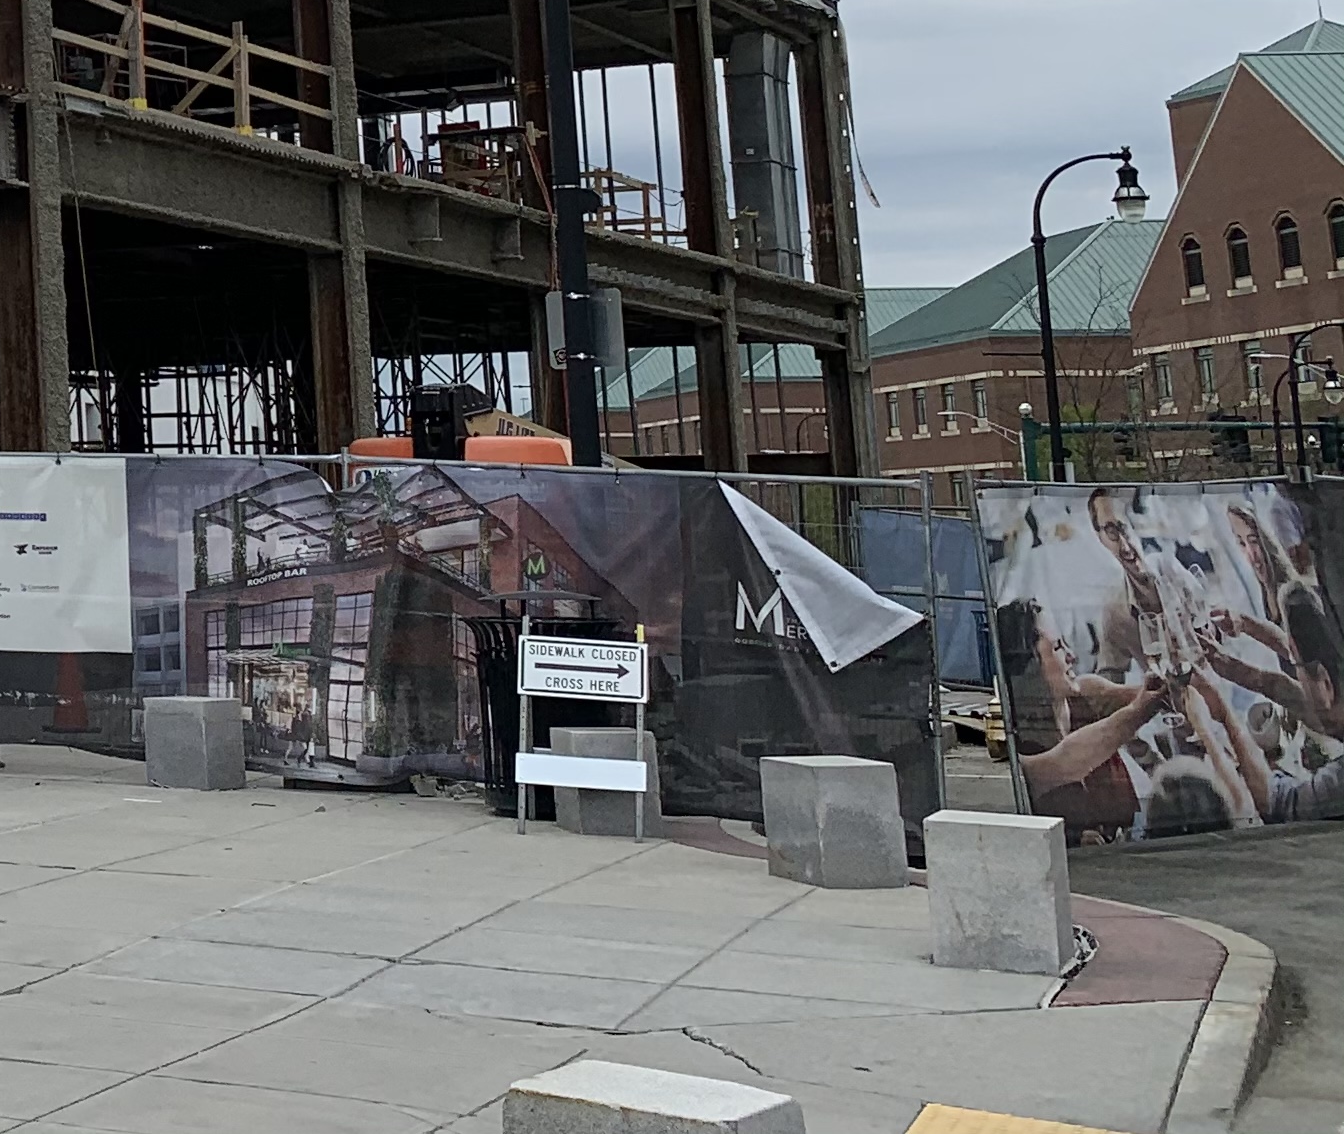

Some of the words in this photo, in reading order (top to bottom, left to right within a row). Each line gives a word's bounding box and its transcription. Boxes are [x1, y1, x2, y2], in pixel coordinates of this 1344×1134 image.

[527, 554, 546, 575] M
[246, 571, 284, 587] ROOFTOP
[284, 567, 308, 578] BAR
[528, 644, 585, 659] SIDEWALK
[591, 648, 637, 662] CLOSED
[545, 676, 584, 690] CROSS
[589, 679, 620, 693] HERE
